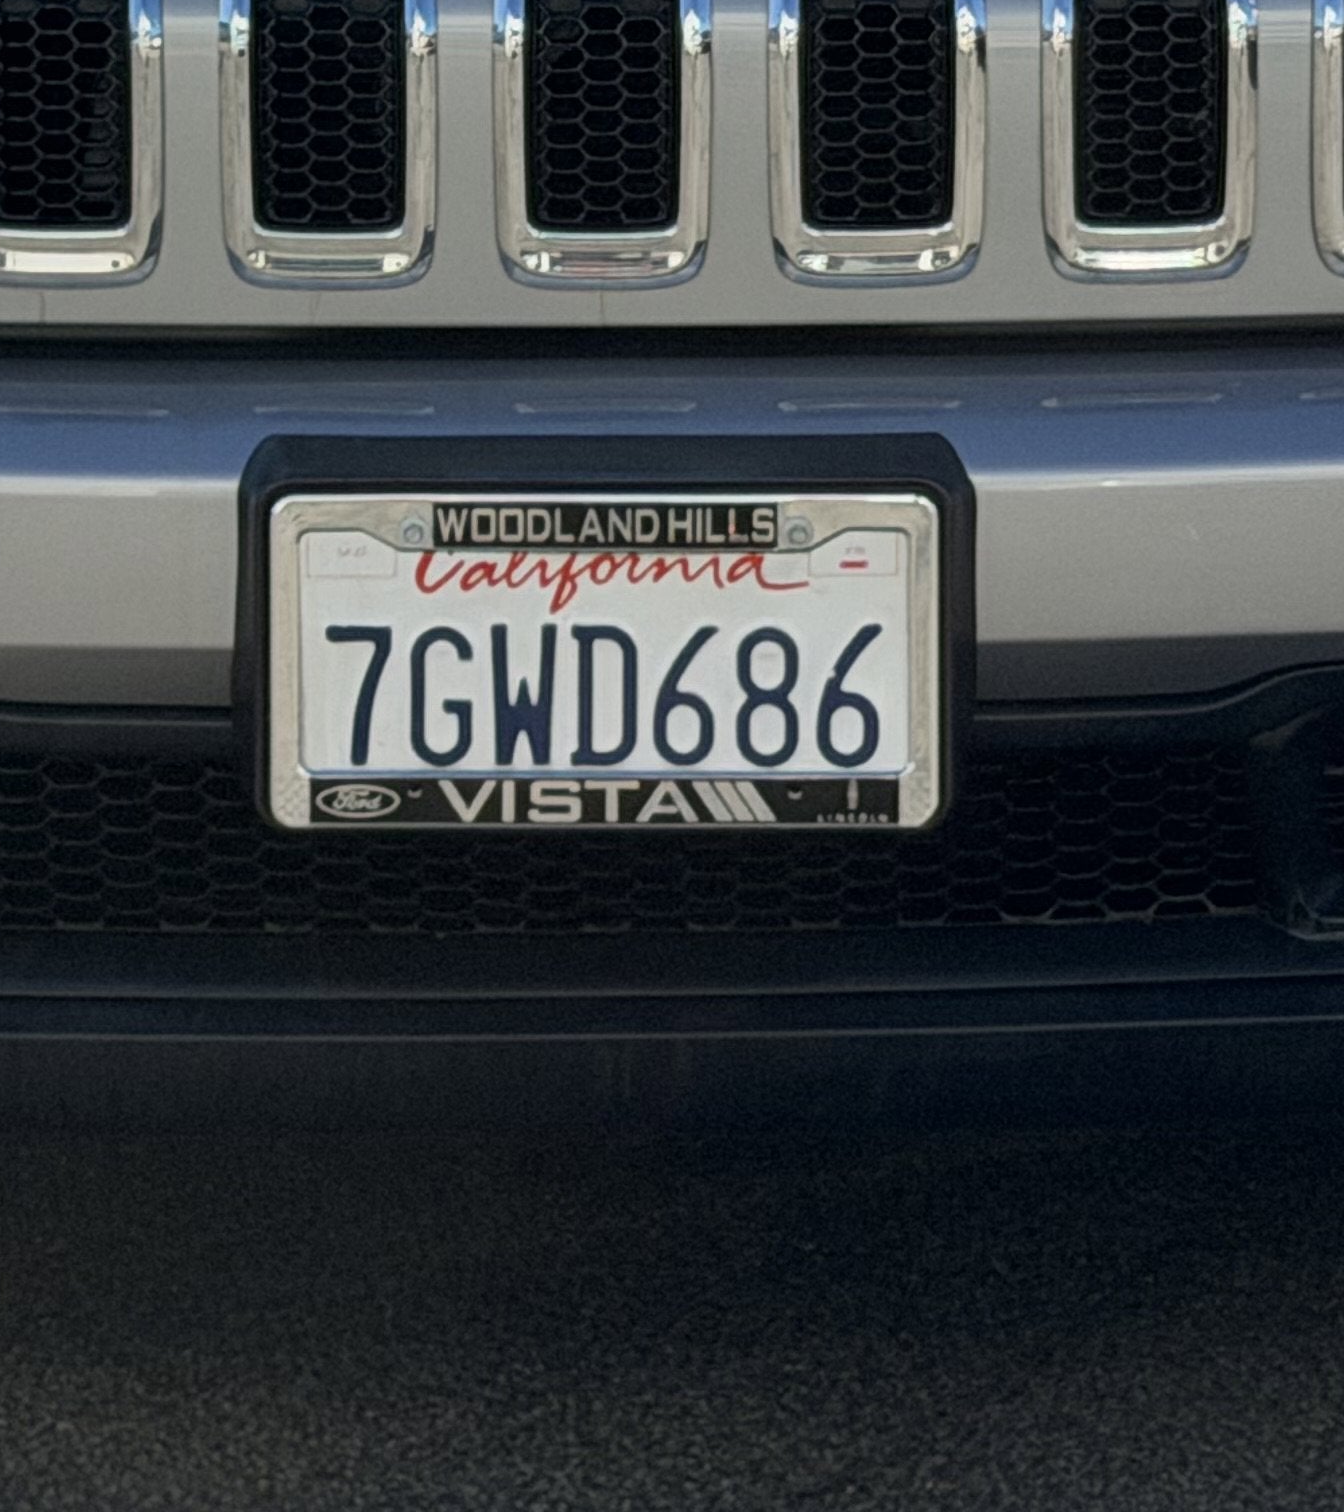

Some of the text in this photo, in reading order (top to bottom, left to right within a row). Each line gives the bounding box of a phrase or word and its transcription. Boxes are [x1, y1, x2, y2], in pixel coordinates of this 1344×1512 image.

[436, 507, 777, 544] WOODLAND HILLS
[324, 622, 884, 769] 7GWD686
[438, 779, 701, 823] VISTA
